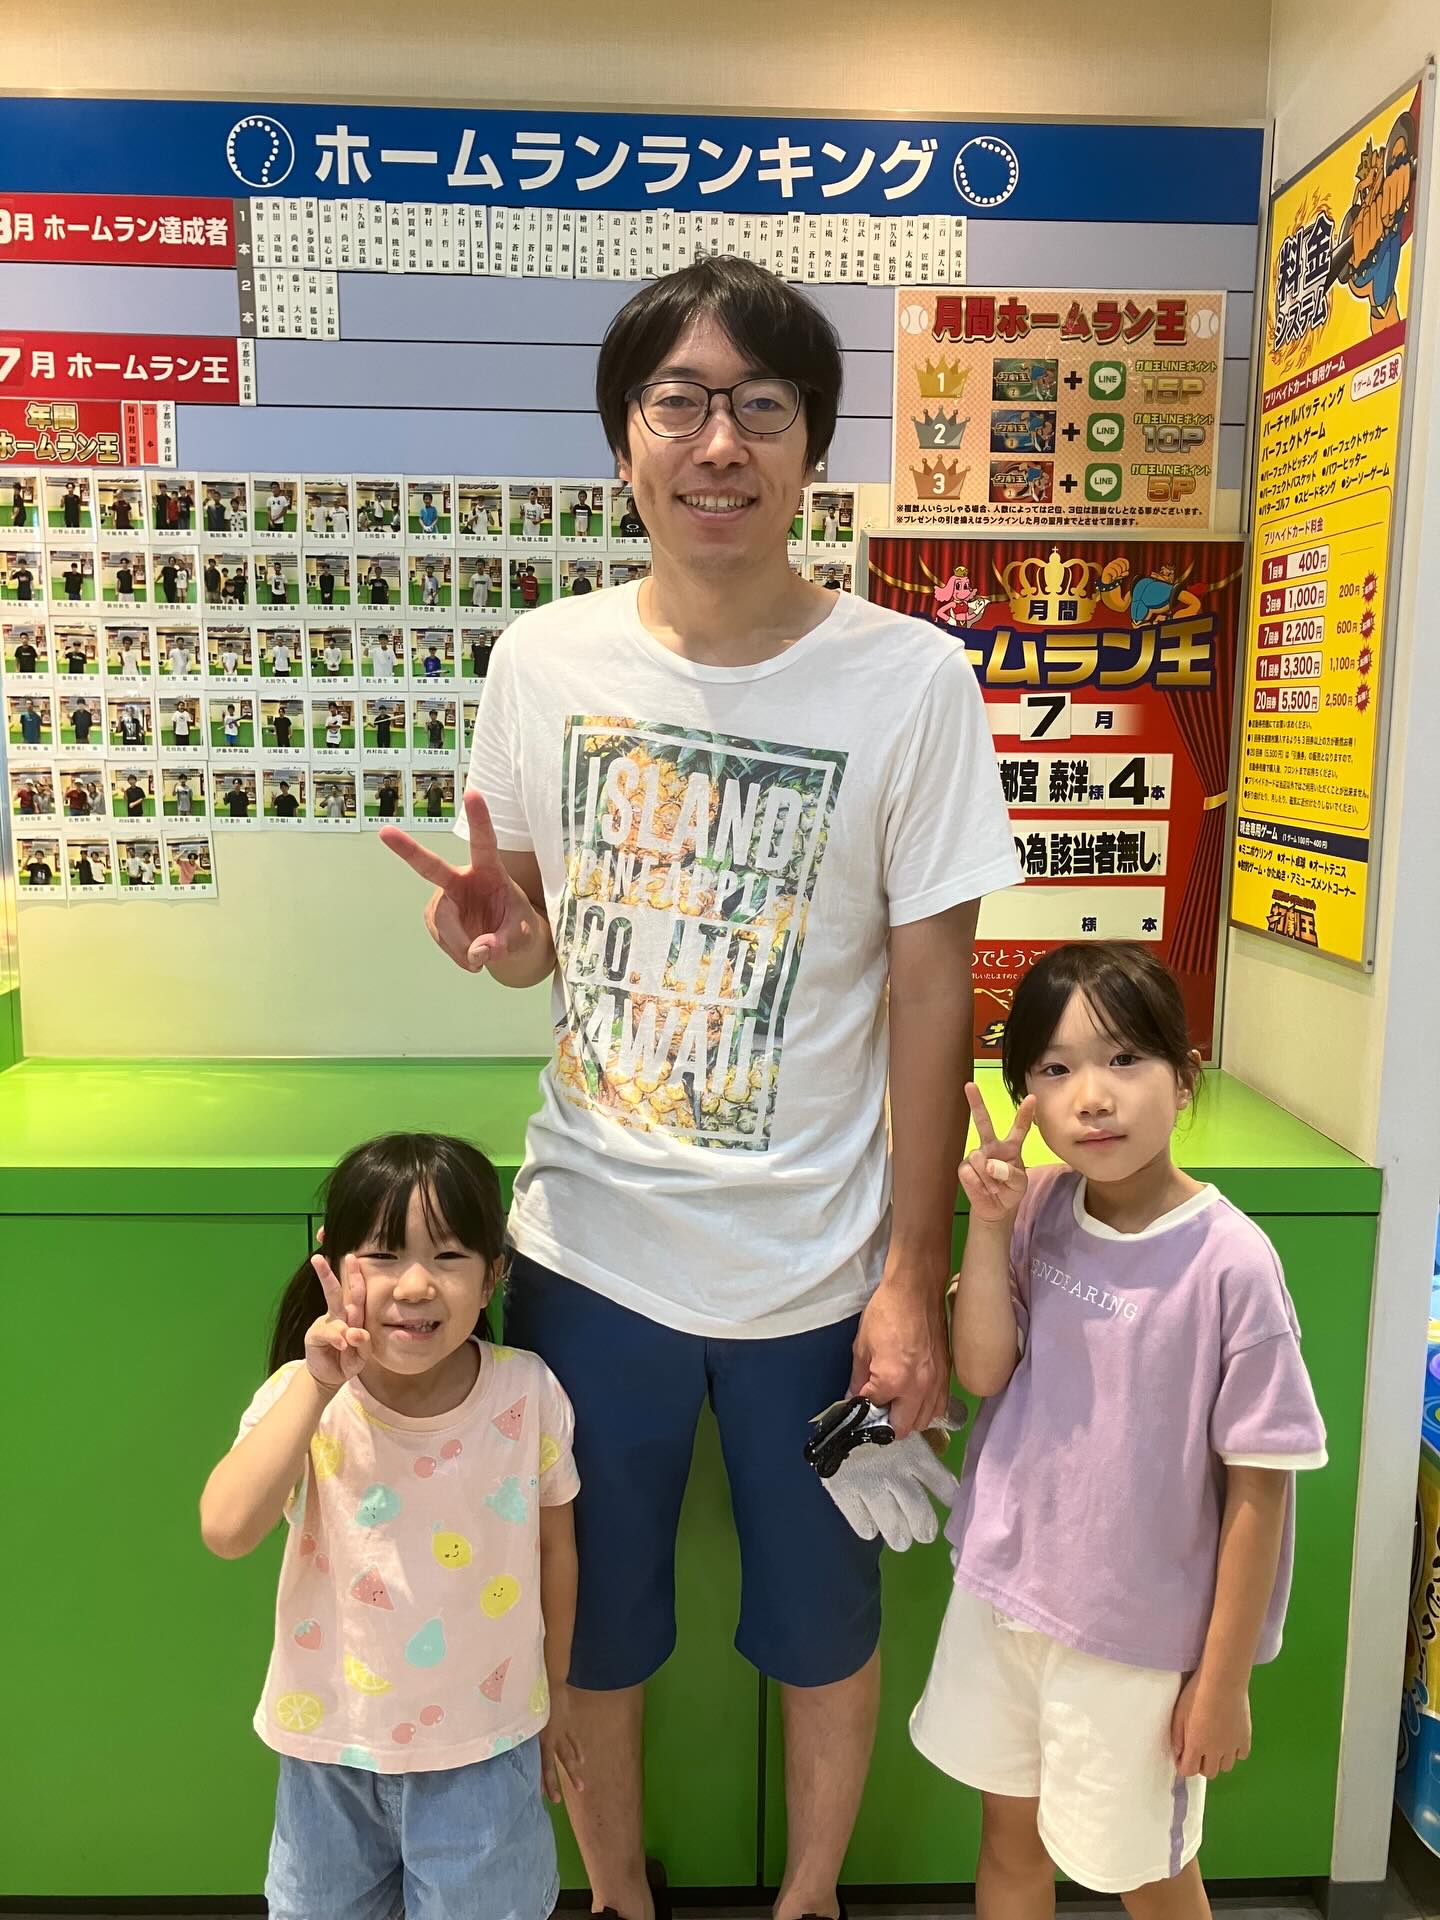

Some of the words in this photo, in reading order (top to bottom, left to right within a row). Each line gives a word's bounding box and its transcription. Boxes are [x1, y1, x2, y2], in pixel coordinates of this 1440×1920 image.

[315, 125, 938, 201] ホームランランキング
[424, 208, 432, 227] 野村
[442, 208, 449, 227] 井上
[458, 208, 466, 226] 北村
[513, 213, 521, 231] 山本
[662, 211, 671, 231] 今津
[43, 214, 229, 247] ホームラン達成者
[776, 219, 785, 239] 中野
[841, 218, 849, 244] 佐々木
[906, 220, 914, 238] 川本
[1278, 210, 1334, 306] 料金
[932, 296, 1188, 345] 月間ホームラン王
[1274, 286, 1328, 352] システム
[0, 347, 56, 383] 7月
[67, 352, 230, 383] ホームラン王
[936, 373, 945, 392] 1
[1098, 375, 1117, 383] LINE
[25, 402, 79, 431] 年間
[934, 424, 945, 444] 2
[1096, 427, 1115, 435] LINE
[1142, 425, 1206, 453] 10P
[0, 431, 121, 463] ホームラン王
[933, 473, 945, 494] 3
[1094, 477, 1113, 485] LINE
[1147, 475, 1197, 502] 5P
[1299, 550, 1327, 572] 400円
[1289, 586, 1324, 610] 1,000円
[1028, 599, 1079, 621] 月間
[1286, 621, 1322, 645] 2,200円
[1284, 656, 1320, 678] 3,300円
[1281, 690, 1318, 712] 5,500円
[1027, 696, 1066, 738] 7
[1095, 710, 1114, 730] 月
[997, 760, 1040, 803] 都宮
[582, 756, 802, 871] ISLAND
[1082, 917, 1098, 932] 様
[1142, 917, 1158, 932] 本
